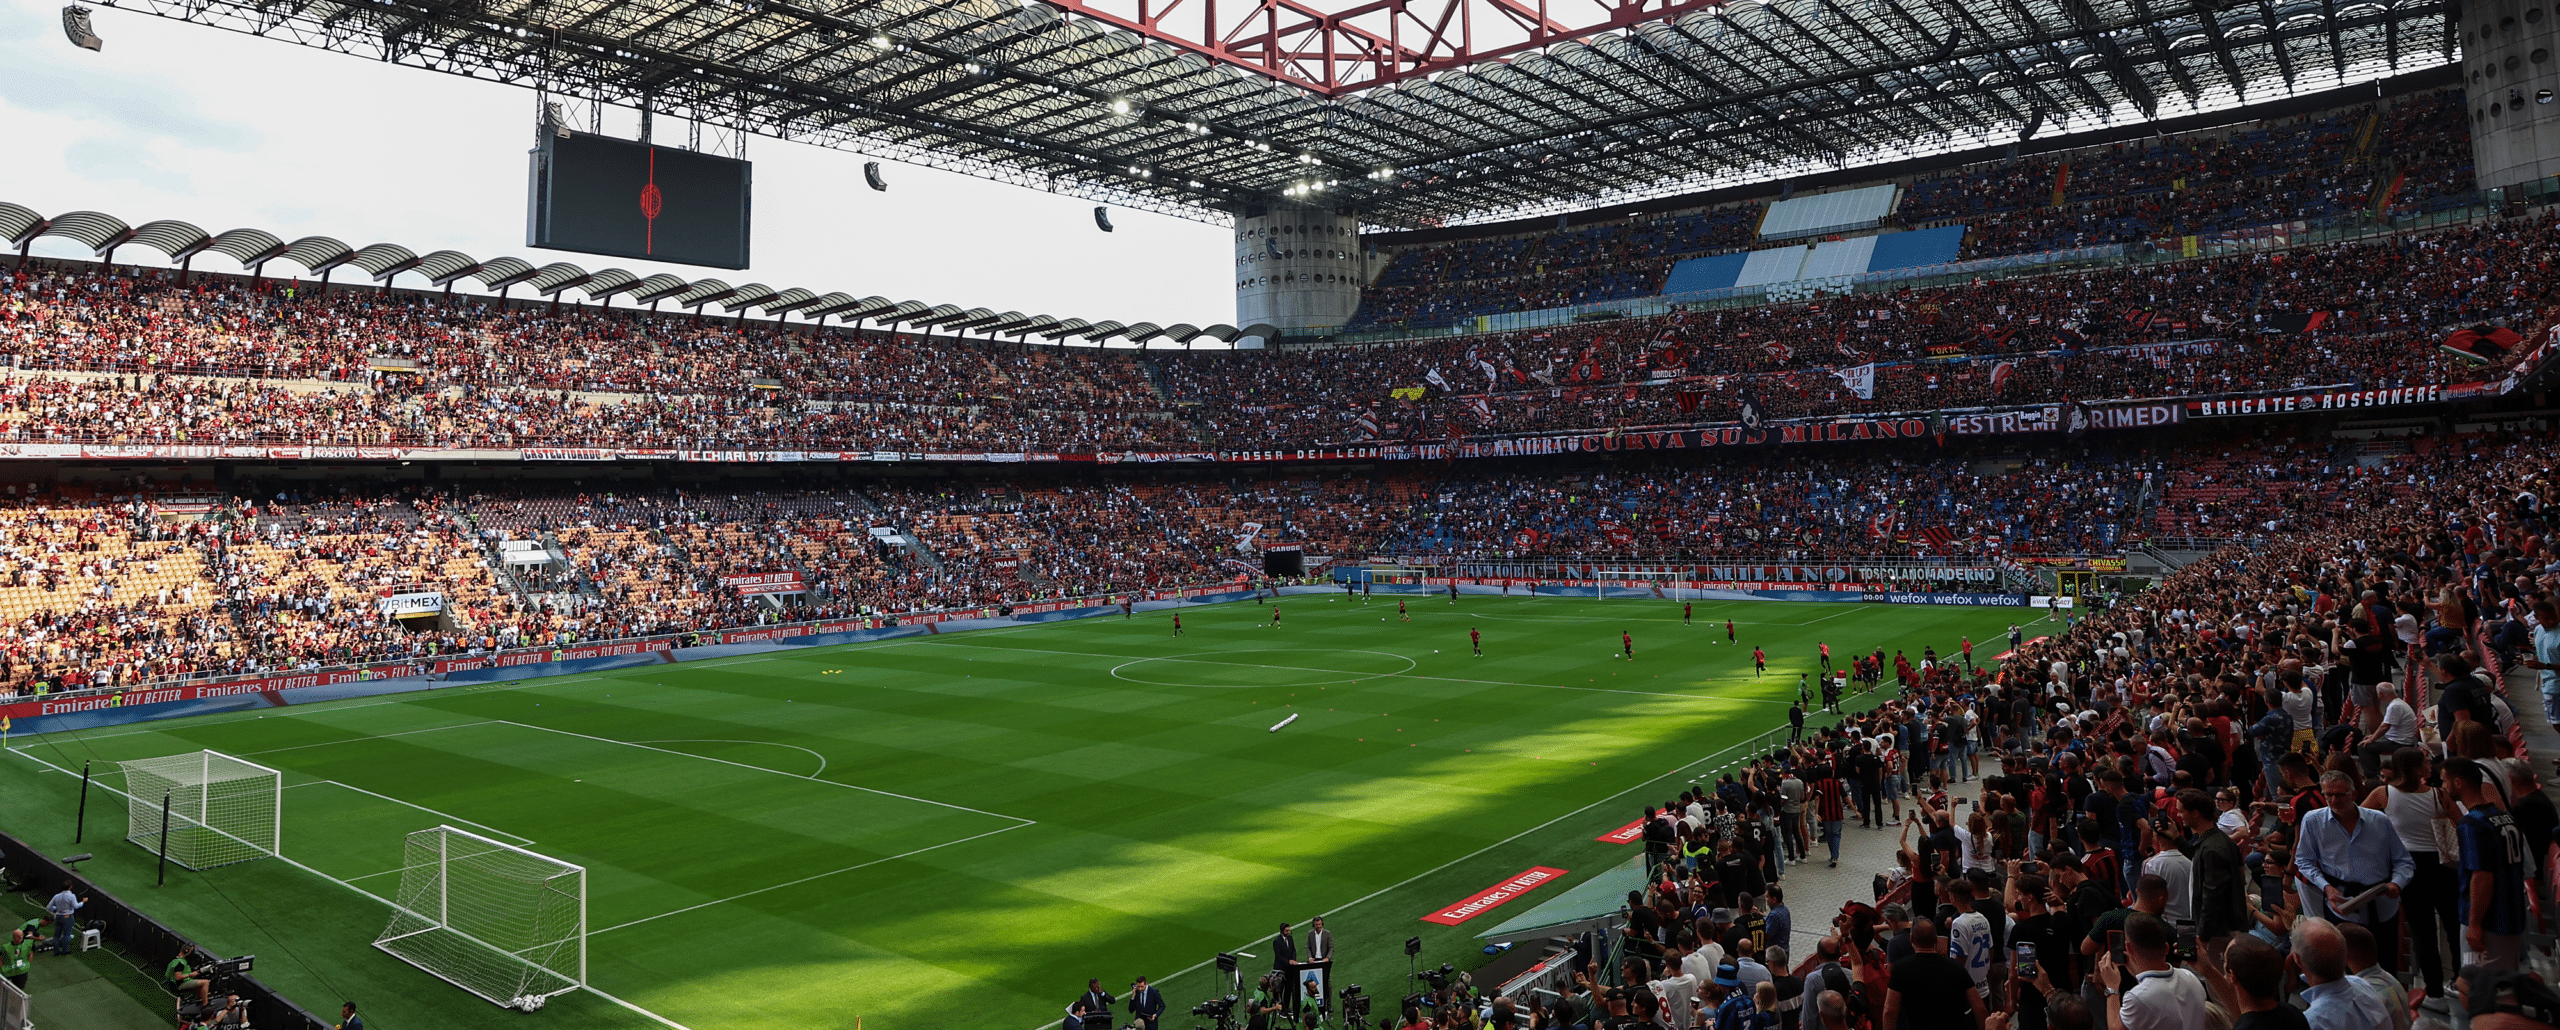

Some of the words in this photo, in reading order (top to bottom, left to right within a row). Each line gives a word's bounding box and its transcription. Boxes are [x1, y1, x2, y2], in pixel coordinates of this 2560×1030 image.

[1652, 368, 1681, 379] NORDEST
[2201, 396, 2295, 415] BRIGATE
[2322, 385, 2438, 409] ROSSONERE
[1957, 415, 2057, 434] ESTREMI
[2091, 404, 2178, 428] RIMEDI
[2020, 411, 2041, 421] Baggio
[1582, 432, 1685, 452] CURVA
[1781, 419, 1925, 443] MILANO
[313, 450, 359, 458] KOSOVO
[523, 449, 602, 459] CASTELFIDARDO
[1232, 451, 1283, 461] FOSSA
[1297, 449, 1323, 460] DEI
[1337, 447, 1383, 458] LEONI
[1493, 438, 1564, 457] MANIERA
[1136, 453, 1170, 462] MILAN
[1271, 545, 1301, 553] CARUGO
[2088, 558, 2126, 567] CHIVASSO
[723, 575, 762, 585] Emirates
[774, 572, 794, 582] BETTER
[1710, 567, 1846, 581] MILANO
[1768, 583, 1804, 591] Emirates
[391, 596, 439, 610] BitMEX
[1889, 593, 1928, 604] wefox
[1933, 594, 1973, 605] wefox
[1978, 594, 2020, 606] wefox
[922, 614, 939, 624] BETTER
[730, 632, 769, 644] Emirates
[772, 629, 782, 639] FLY
[782, 627, 802, 638] BETTER
[551, 649, 598, 661] mirates
[601, 647, 613, 656] FLY
[613, 644, 637, 655] BETTER
[645, 641, 671, 652] Emir
[503, 655, 516, 667] FLY
[516, 652, 542, 665] BETTER
[330, 669, 387, 684] Emirtes
[391, 666, 407, 678] FLY
[196, 682, 262, 699] Emirates
[267, 679, 283, 691] FLY
[284, 675, 318, 689] BETTER
[42, 697, 109, 715] Emirate
[124, 693, 143, 707] FLY
[144, 689, 182, 704] BETTER
[1703, 809, 1712, 825] 8
[2501, 823, 2522, 864] 10
[1442, 890, 1510, 919] Emirates
[1501, 881, 1520, 894] FLY
[1517, 870, 1552, 887] BETTER
[1751, 929, 1765, 953] 10
[1971, 933, 1990, 969] 23
[2463, 950, 2488, 965] NIKE
[1658, 996, 1672, 1023] 8
